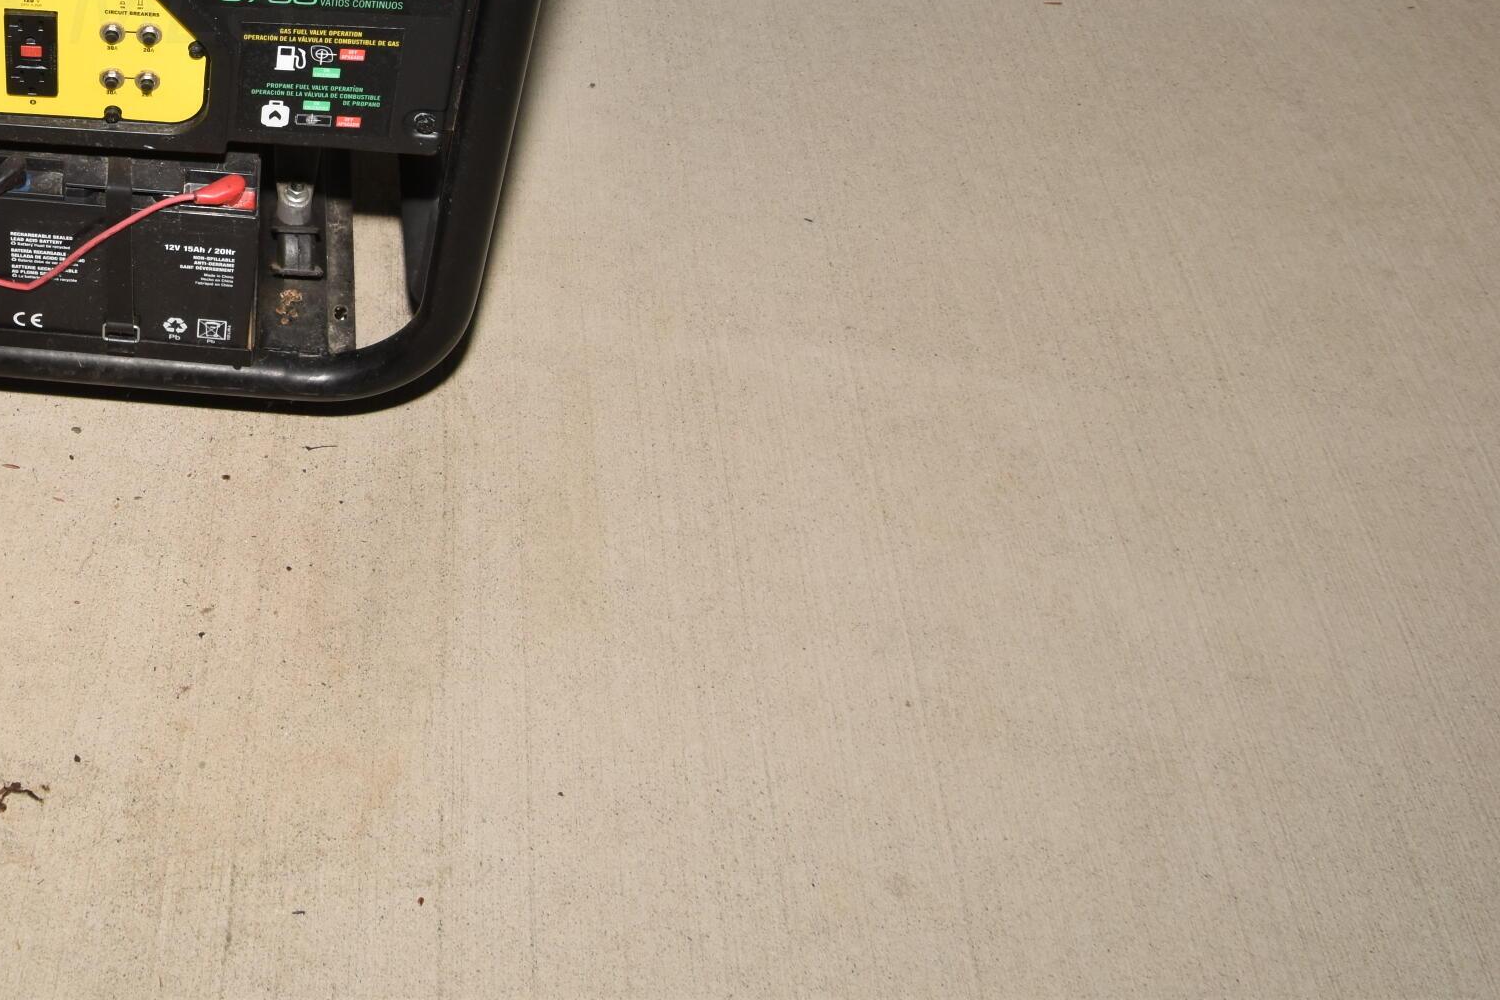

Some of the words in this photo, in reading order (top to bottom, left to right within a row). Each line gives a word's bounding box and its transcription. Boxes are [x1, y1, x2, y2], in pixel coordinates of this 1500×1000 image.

[352, 0, 404, 10] CONTINUOS
[334, 38, 376, 46] COMBUSTIBLE
[251, 88, 285, 96] OPERACIÓN
[304, 90, 329, 98] VÁLVULA
[184, 245, 206, 253] 15Ah
[214, 248, 237, 256] 20Hr
[193, 255, 235, 263] NON-SPILLABLE
[13, 311, 44, 328] CE
[168, 333, 181, 341] Pb
